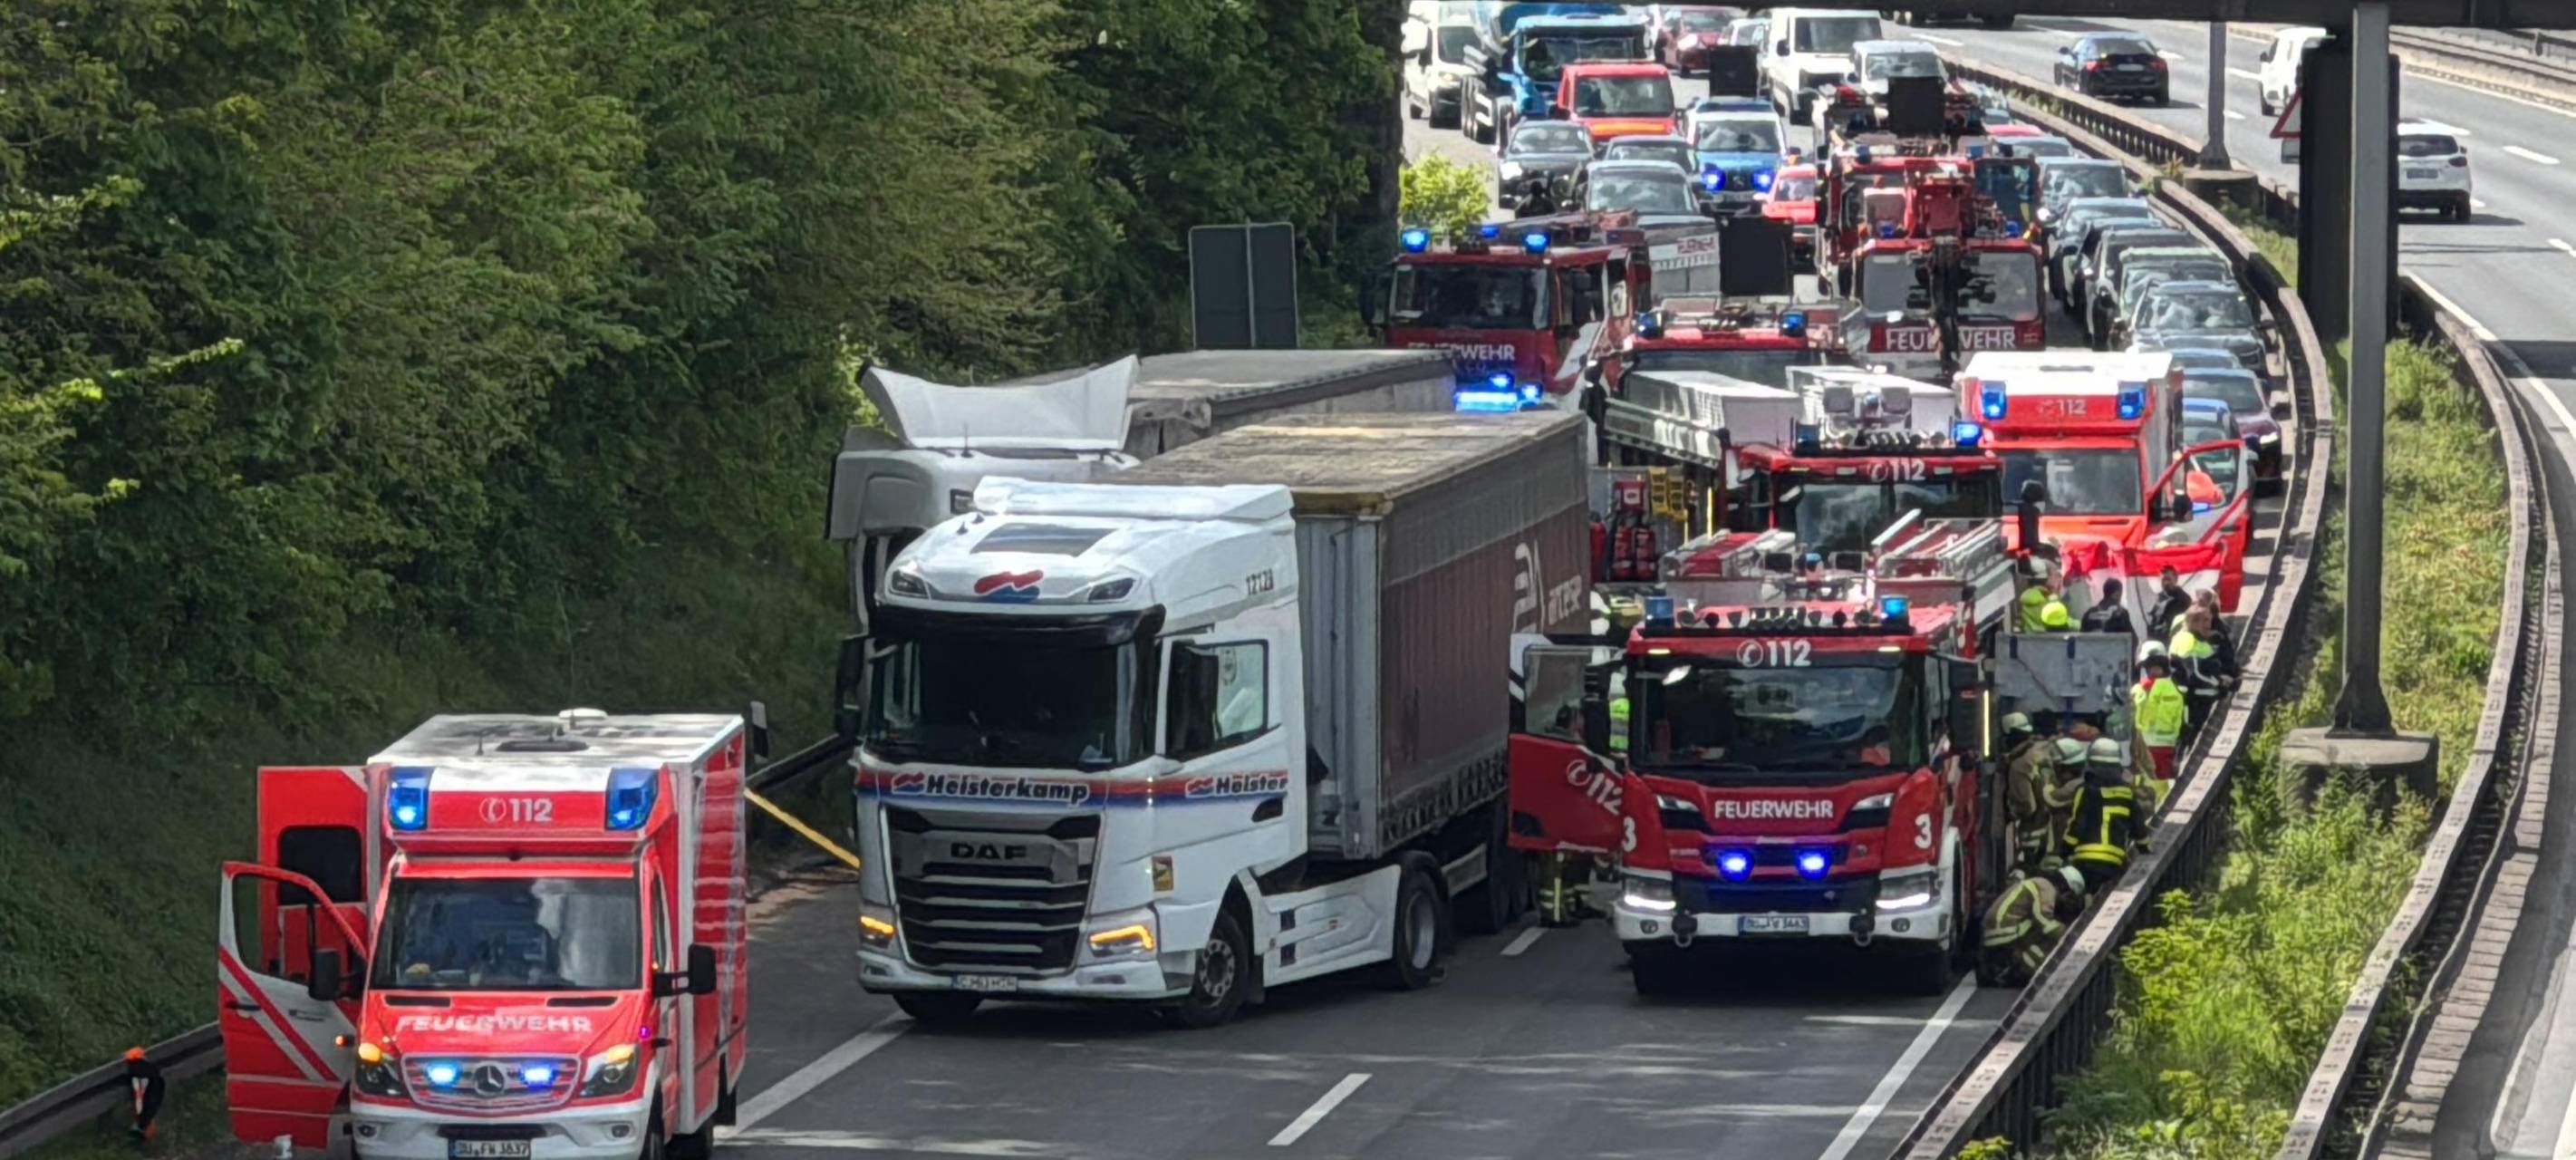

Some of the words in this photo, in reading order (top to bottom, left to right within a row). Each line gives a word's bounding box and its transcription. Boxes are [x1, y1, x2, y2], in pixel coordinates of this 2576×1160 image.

[2058, 399, 2087, 417] 112
[1889, 457, 1925, 481] 112
[1766, 639, 1811, 666] 112
[926, 773, 1089, 805] Heisterkamp
[1586, 772, 1623, 816] 112
[509, 798, 553, 822] 112
[1714, 799, 1834, 818] FEUERWEHR
[1621, 816, 1637, 852] 3
[1915, 814, 1933, 848] 3
[951, 842, 1027, 860] DAF
[395, 1015, 593, 1033] FEUERWEHR
